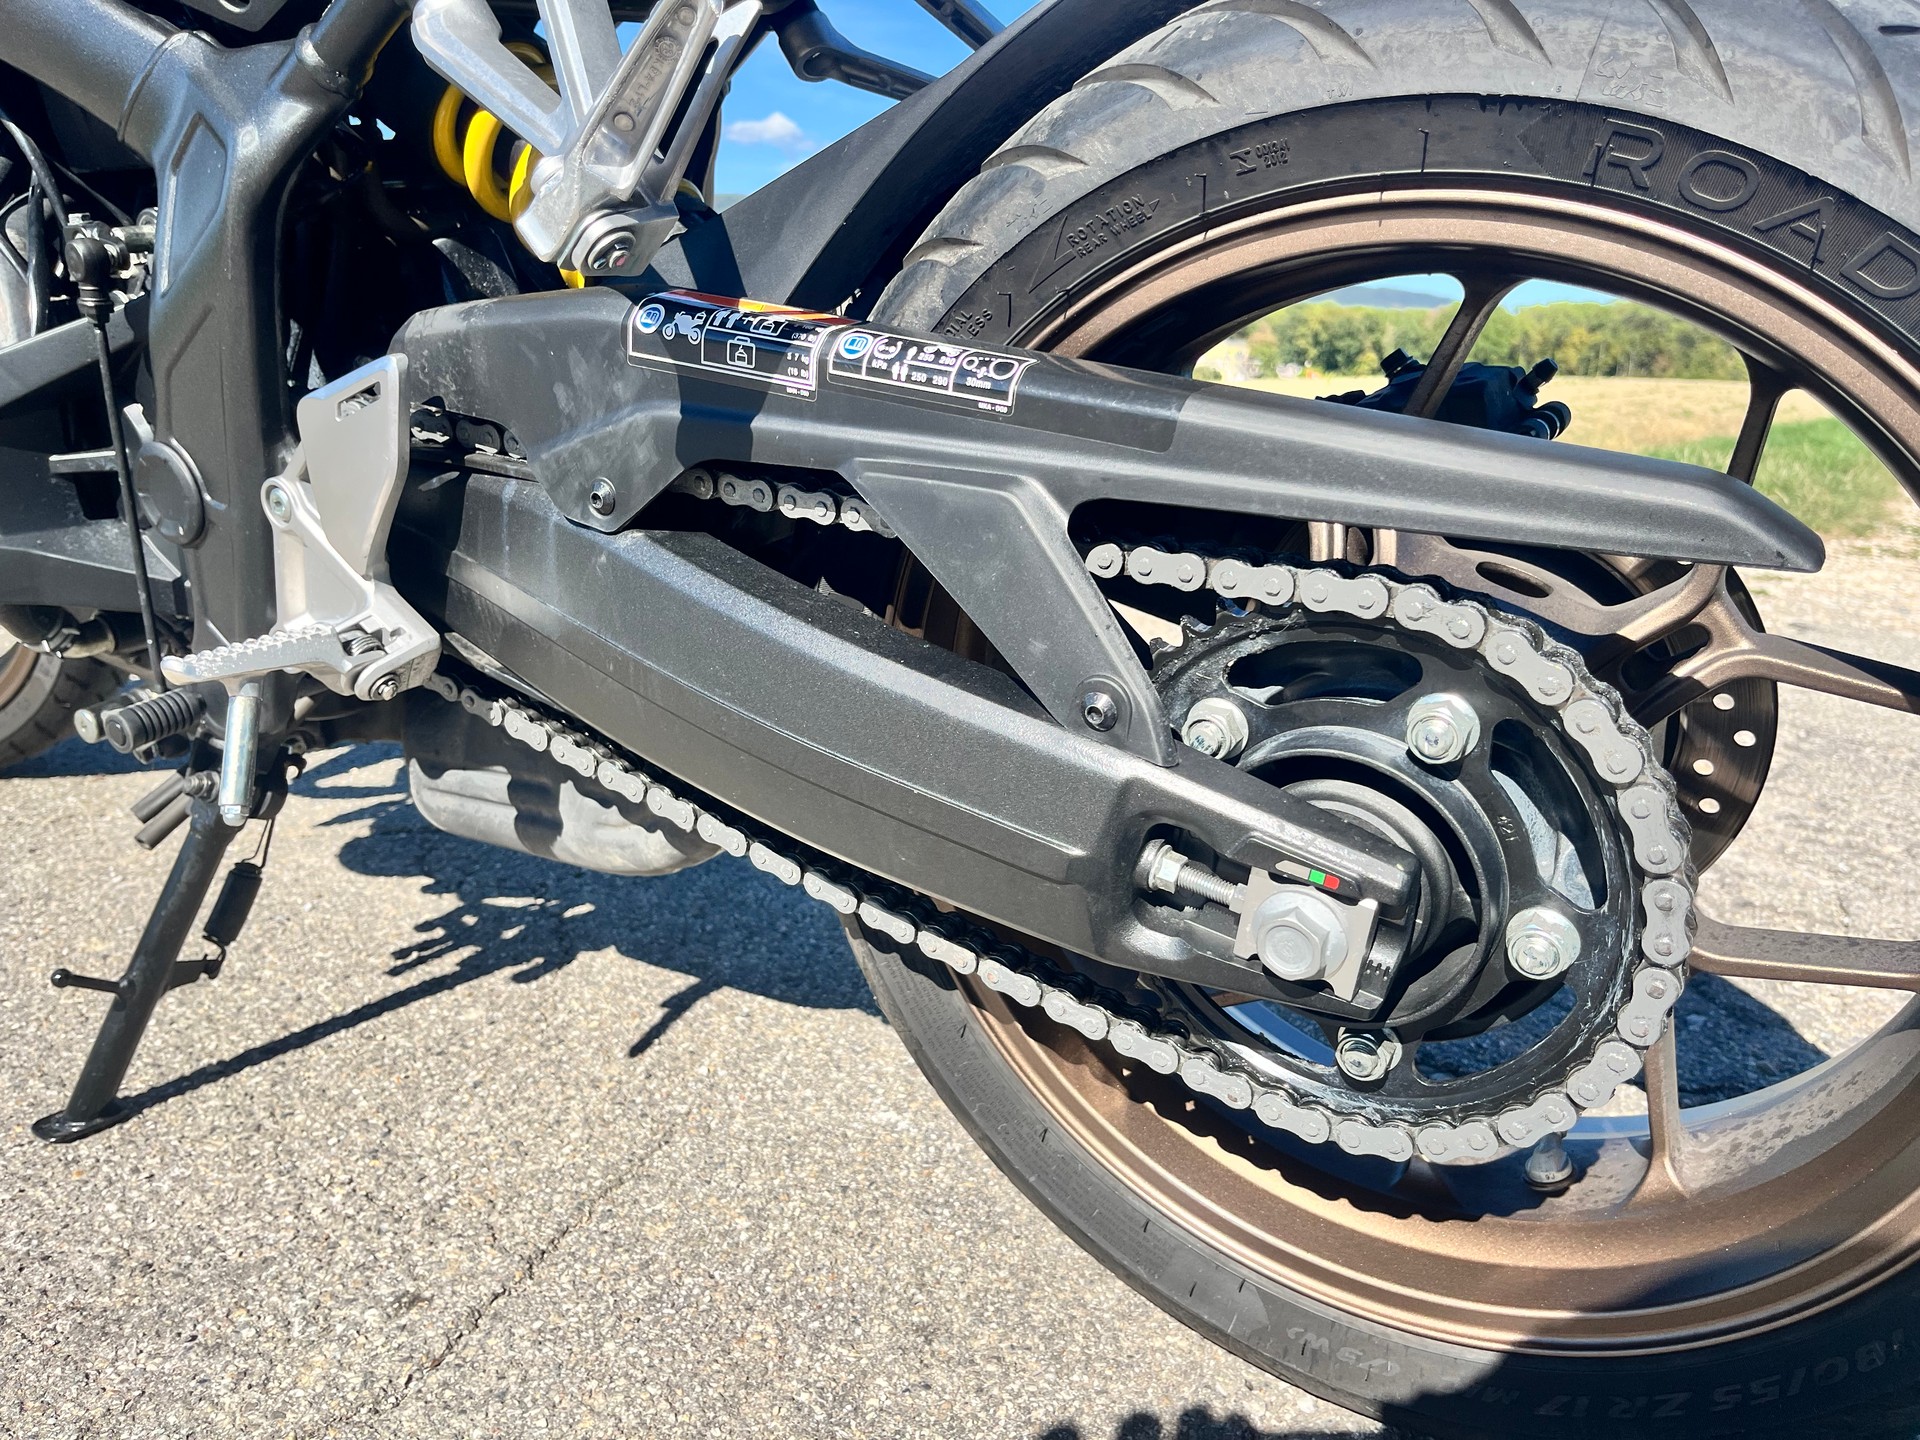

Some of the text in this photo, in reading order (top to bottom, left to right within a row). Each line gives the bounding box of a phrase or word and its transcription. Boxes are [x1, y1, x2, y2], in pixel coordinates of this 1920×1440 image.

[1066, 193, 1144, 248] ROTATION
[1583, 118, 1920, 299] ROAD
[1076, 209, 1153, 258] REAR WHEEL
[871, 359, 888, 370] kPa
[911, 371, 948, 387] 250 290
[966, 376, 991, 390] 30mm
[1533, 1394, 1589, 1419] 17
[1607, 1391, 1693, 1419] ZR
